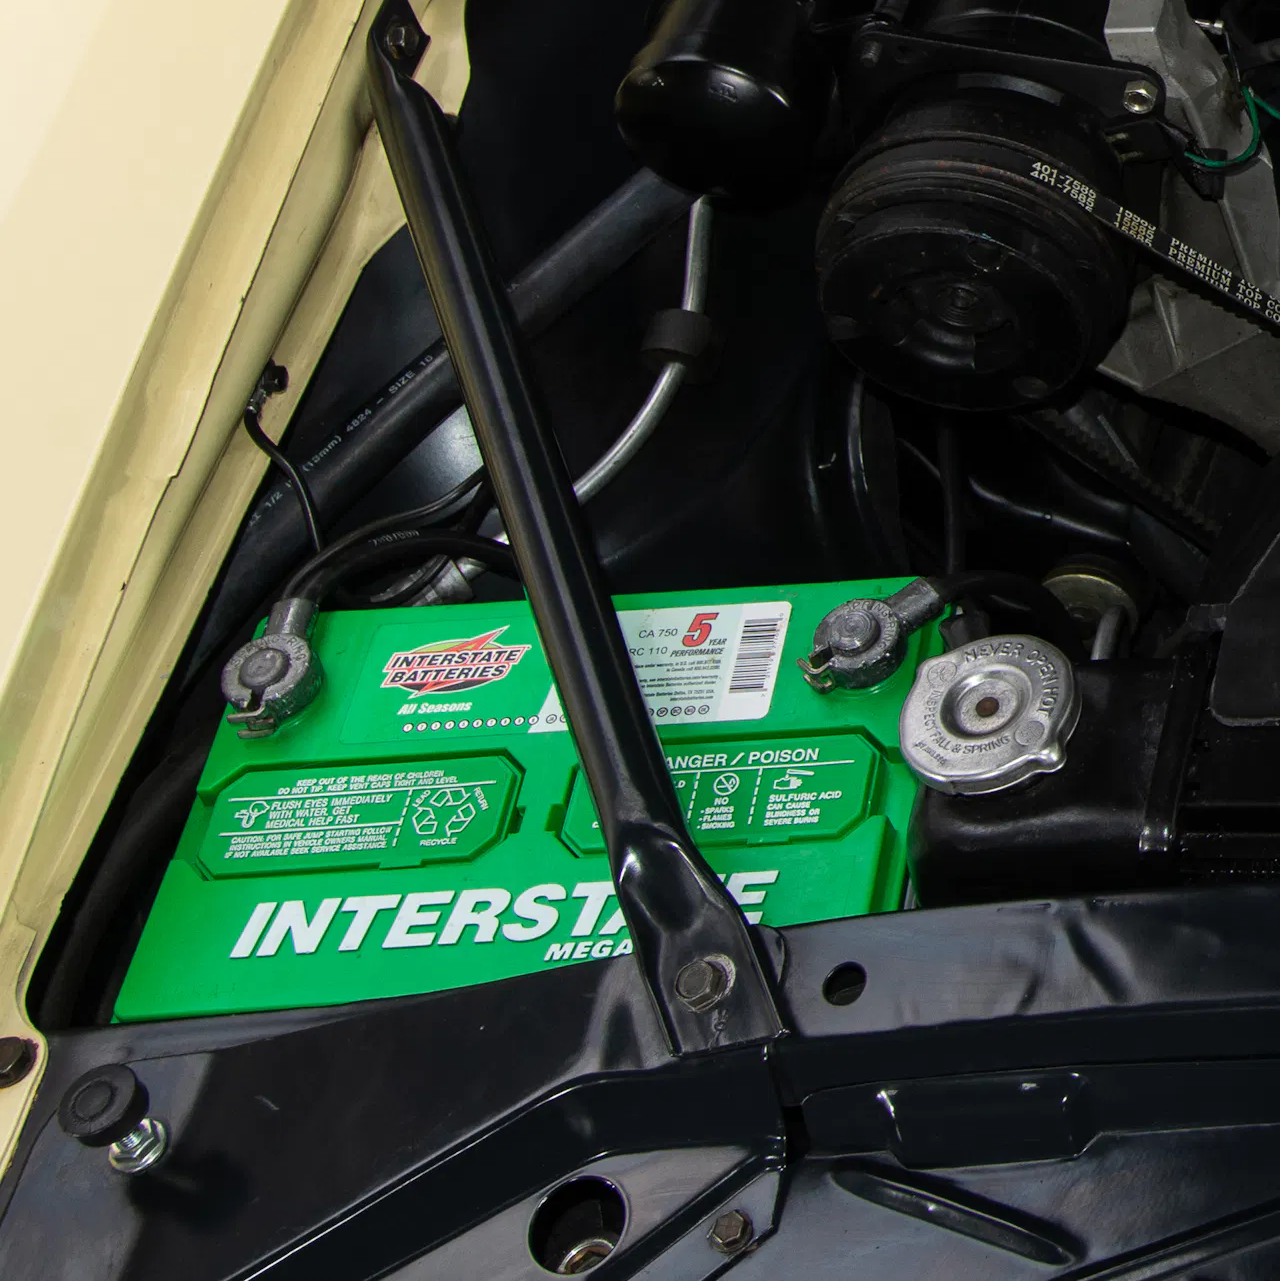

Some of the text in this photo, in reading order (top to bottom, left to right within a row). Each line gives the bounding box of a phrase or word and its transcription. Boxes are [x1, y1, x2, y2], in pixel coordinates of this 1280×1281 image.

[1032, 162, 1096, 199] 401-7585
[1116, 214, 1154, 240] 15585
[1168, 247, 1231, 286] PREMIUM
[1237, 283, 1263, 301] TOP
[302, 435, 342, 471] (13mm)
[388, 370, 416, 394] SIZE
[419, 355, 434, 366] 10
[638, 629, 678, 638] CA 750
[682, 613, 719, 648] 5
[708, 638, 727, 646] YEAR
[391, 649, 521, 668] INTERSTATE
[629, 646, 668, 656] RC 110
[670, 647, 725, 658] PERFORMANCE
[390, 664, 507, 683] BATTERIES
[963, 642, 1059, 718] NEVER OPEN HOT
[398, 702, 472, 715] All Seasons
[923, 689, 1011, 755] INSPECT & SPRING
[665, 753, 727, 769] ANGER
[748, 747, 819, 764] POISON
[277, 787, 290, 795] DO
[291, 786, 309, 794] NOT
[327, 783, 348, 792] KEEP
[349, 782, 370, 790] VENT
[371, 781, 391, 789] CAPS
[394, 779, 417, 787] TIGHT
[436, 776, 458, 784] LEVEL
[296, 770, 444, 787] KEEP OUT OF THE REACH OF CHILDREN
[270, 794, 393, 811] FLUSH EYES IMMEDIATELY
[412, 790, 431, 808] LEAD
[474, 787, 489, 811] RETURN
[714, 797, 729, 805] NO
[768, 790, 842, 803] SULFURIC ACID
[269, 809, 292, 819] WITH
[332, 806, 352, 815] GET
[765, 808, 820, 818] BLINDNESS OR
[265, 814, 360, 829] MEDICAL HELP FAST
[764, 816, 819, 826] SEVERE BURNS
[266, 834, 281, 842] FOR
[283, 833, 302, 841] SAFE
[303, 831, 323, 839] JUMP
[325, 828, 361, 838] STARTING
[362, 826, 393, 835] FOLLOW
[419, 837, 458, 846] RECYCLE
[229, 841, 282, 851] INSTRUCTIONS
[293, 838, 323, 847] VEHICLE
[325, 836, 356, 845] OWNERS
[233, 851, 249, 859] NOT
[251, 848, 289, 858] AVAILABLE
[290, 847, 309, 855] SEEK
[310, 845, 341, 854] SERVICE
[229, 869, 780, 958] INTERSTE
